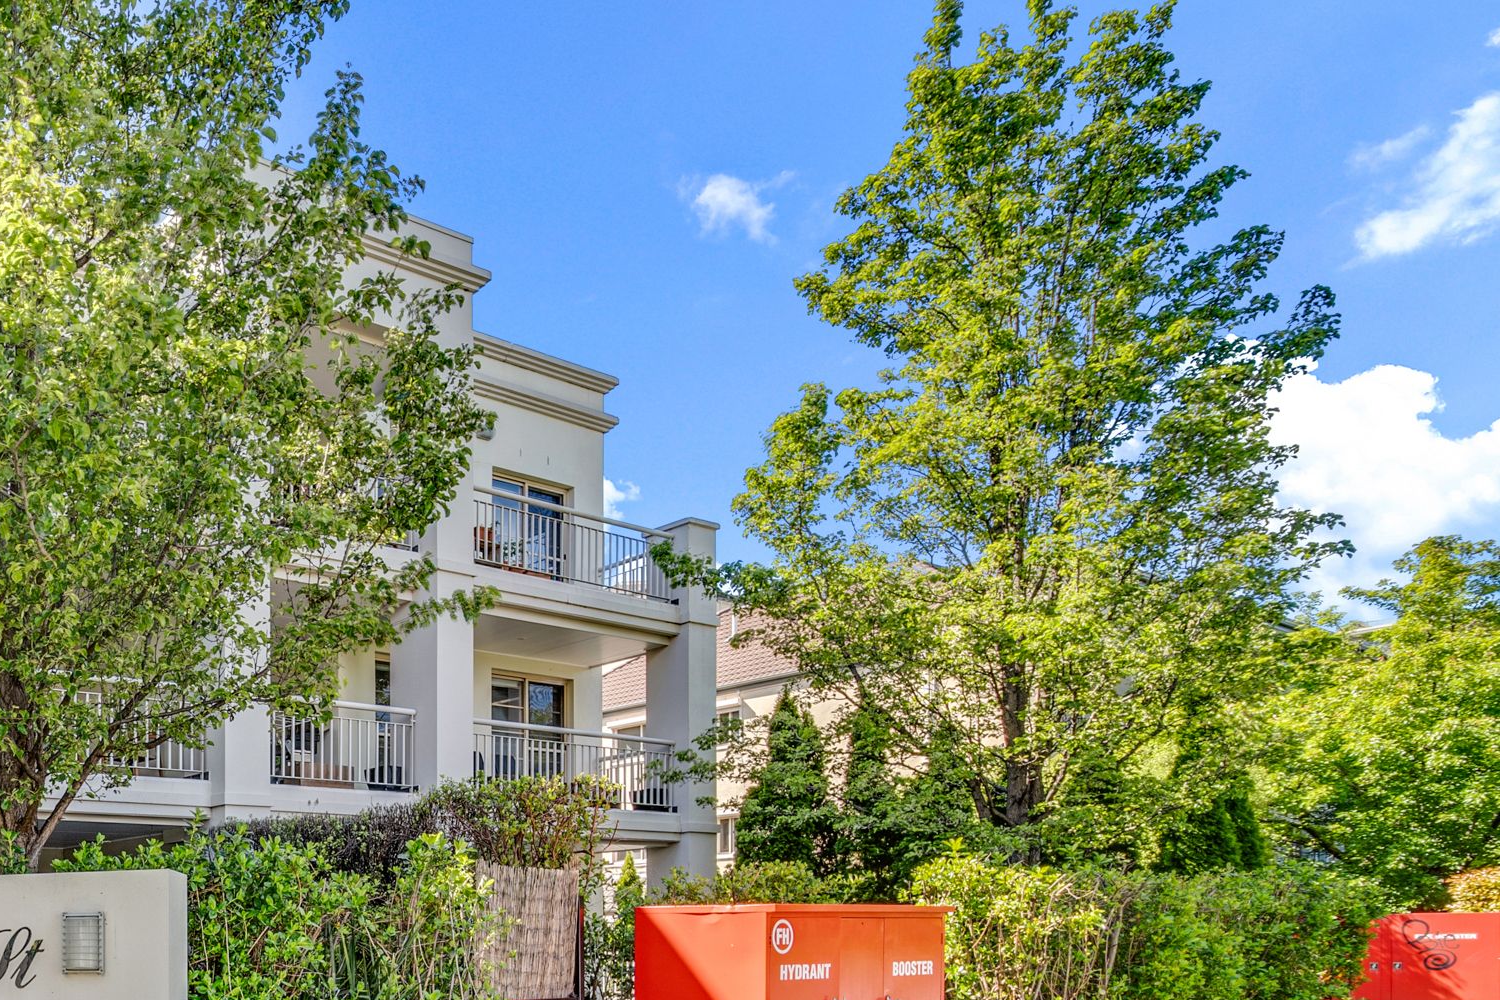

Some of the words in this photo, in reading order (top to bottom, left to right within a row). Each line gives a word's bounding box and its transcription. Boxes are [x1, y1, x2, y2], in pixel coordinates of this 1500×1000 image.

[776, 927, 790, 945] FH
[780, 963, 832, 981] HYDRANT
[892, 960, 933, 977] BOOSTER
